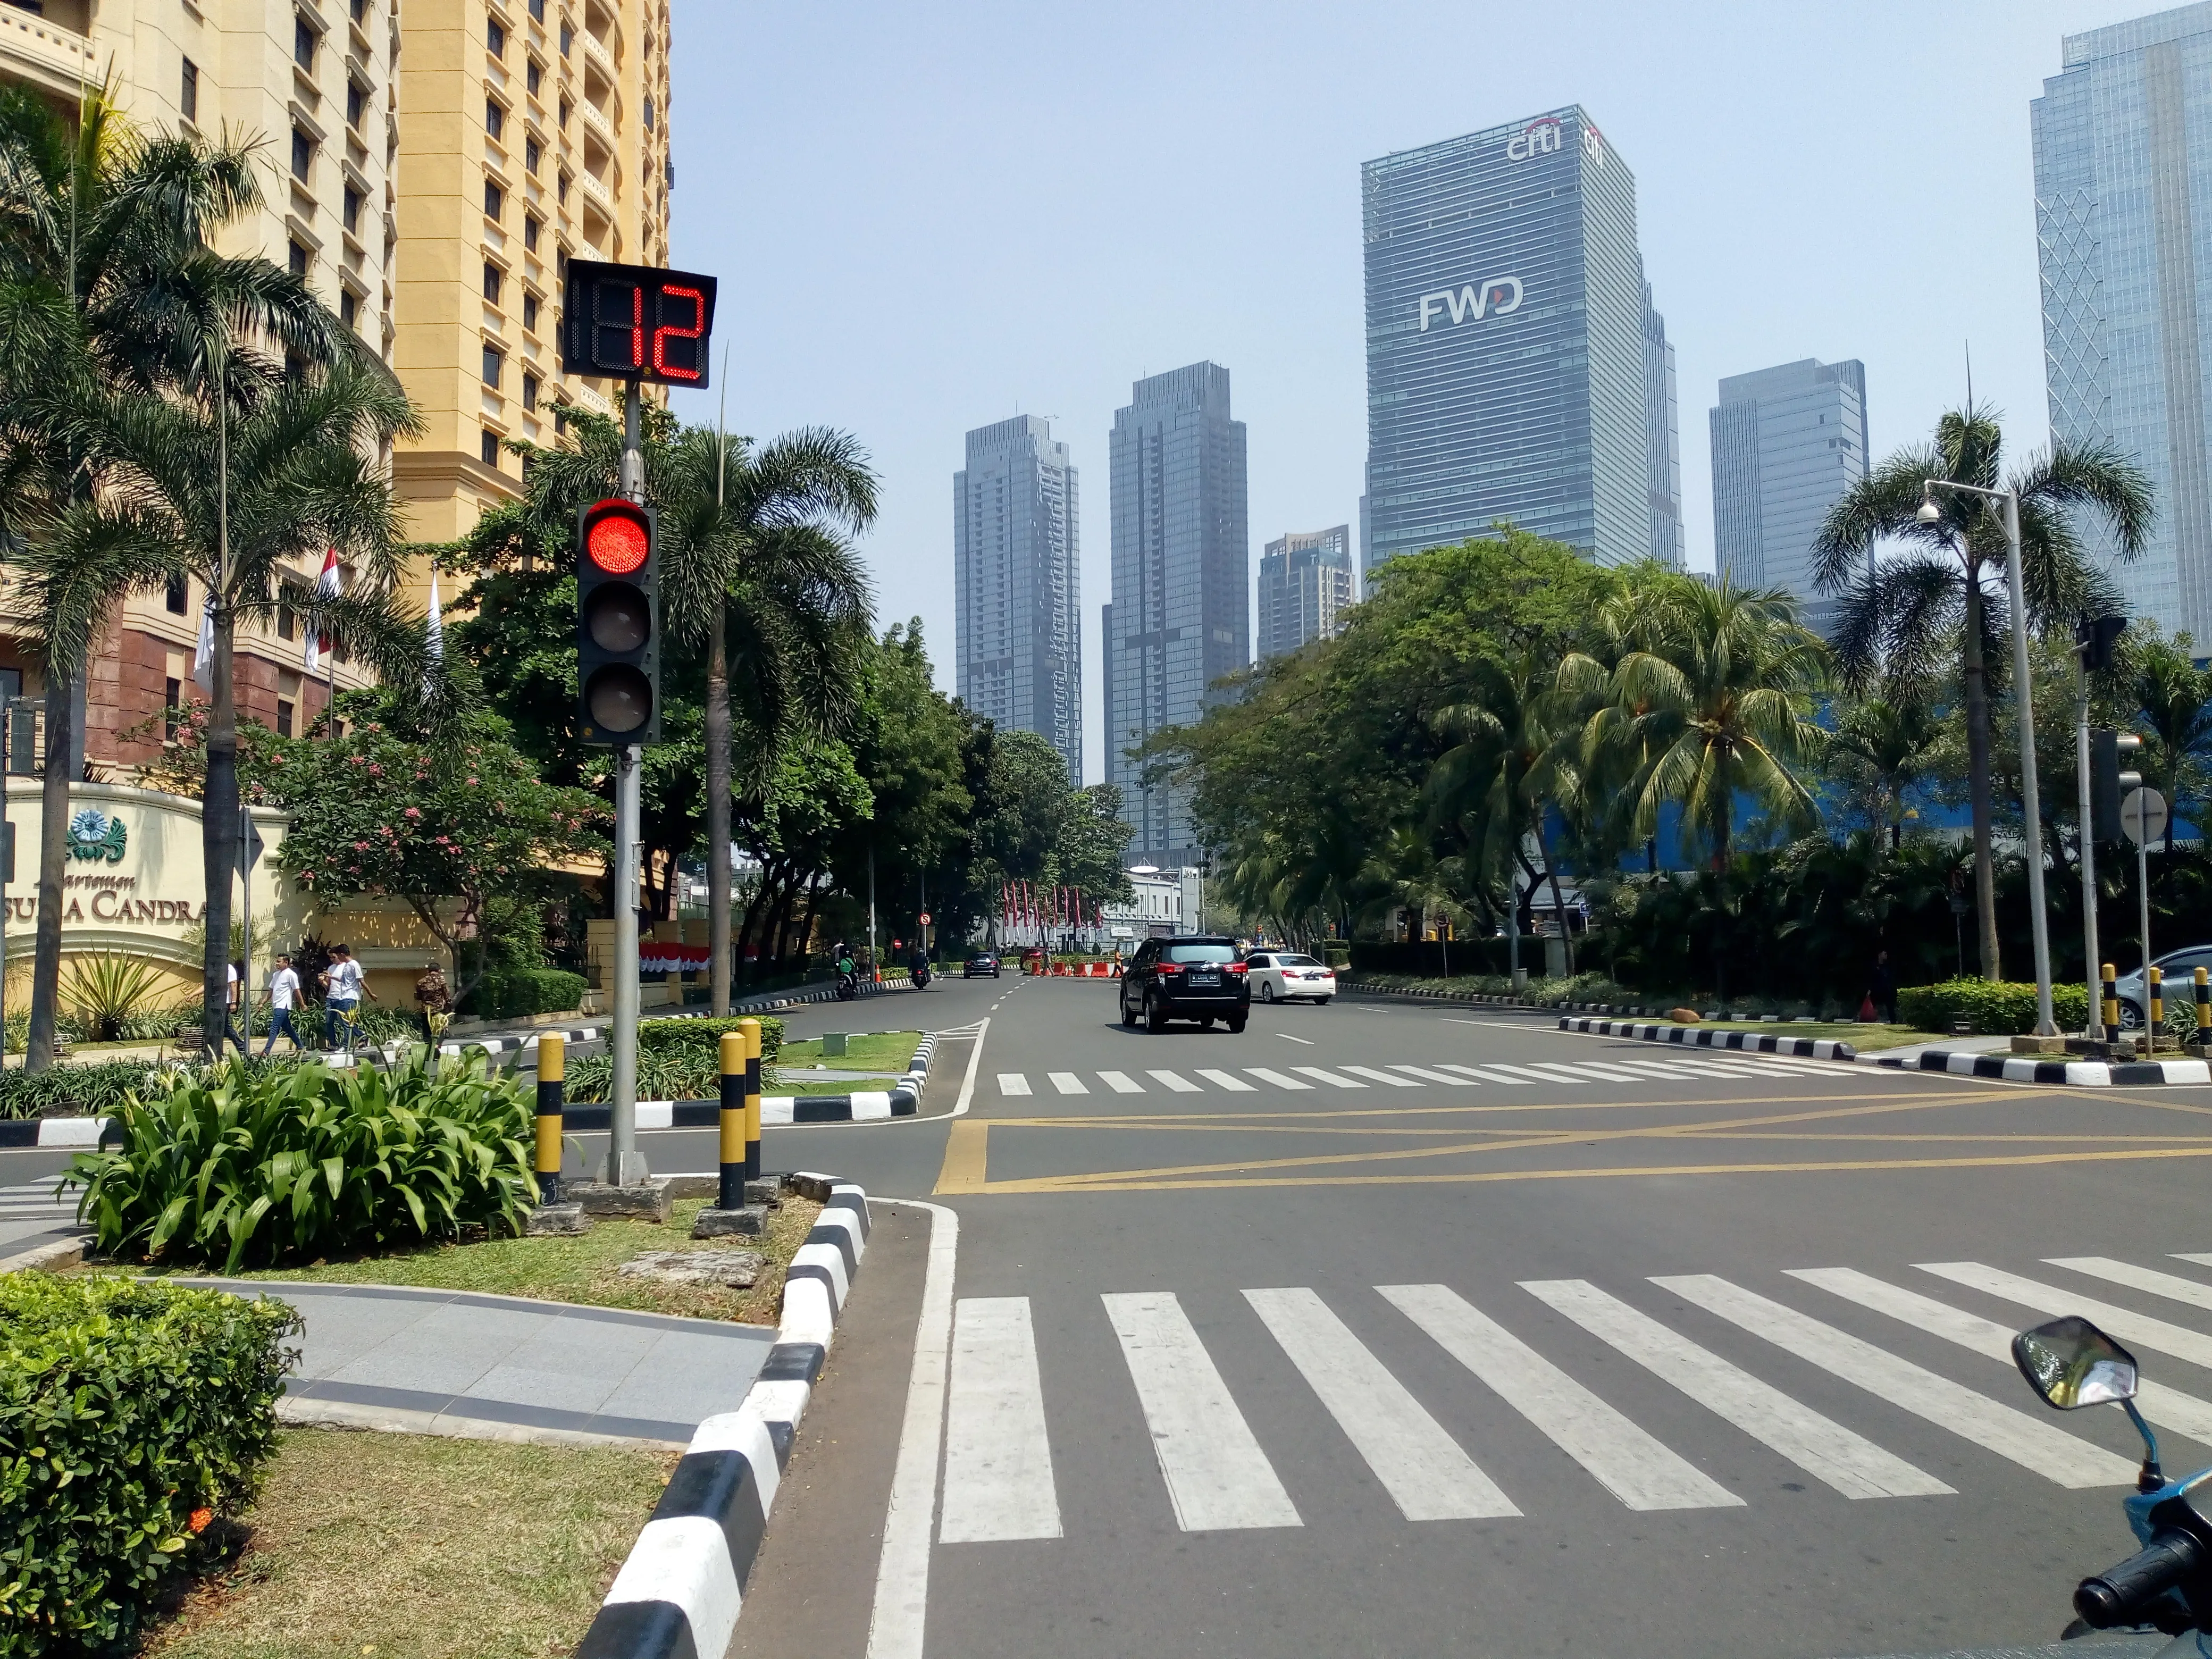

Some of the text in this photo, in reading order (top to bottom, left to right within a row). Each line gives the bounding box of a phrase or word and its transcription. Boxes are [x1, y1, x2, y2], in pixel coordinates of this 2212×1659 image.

[1507, 121, 1562, 161] citi
[1584, 128, 1603, 169] citi
[1420, 275, 1523, 332] FWD
[633, 283, 704, 380] 12
